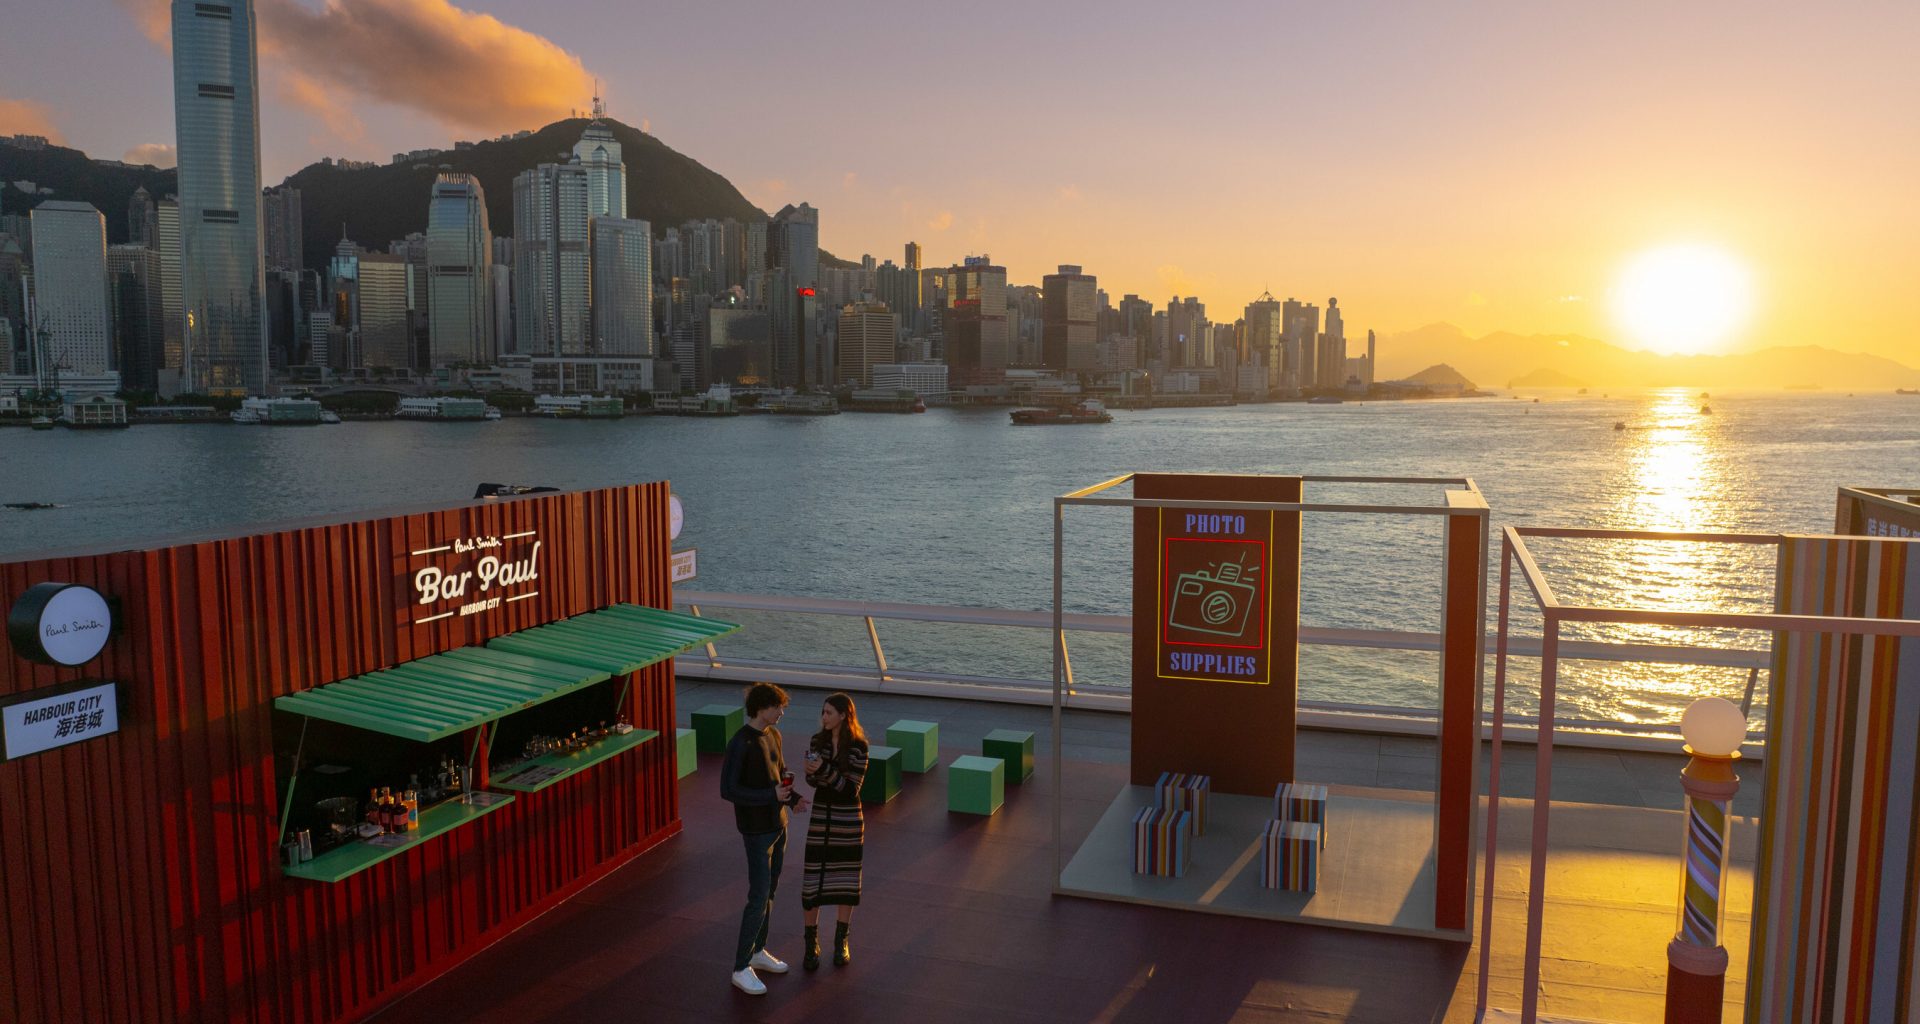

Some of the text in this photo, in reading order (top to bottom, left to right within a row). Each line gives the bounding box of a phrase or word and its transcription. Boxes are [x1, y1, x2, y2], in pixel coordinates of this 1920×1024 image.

[1185, 513, 1246, 535] PHOTO
[455, 536, 502, 554] Paul Smith
[415, 541, 541, 605] Bar Paul
[460, 597, 501, 616] HARBOUR CITY
[46, 621, 104, 637] Paul Smith
[1170, 652, 1256, 676] SUPPLIES
[24, 694, 103, 726] HARBOUR CITY
[54, 709, 105, 739] 海港城
